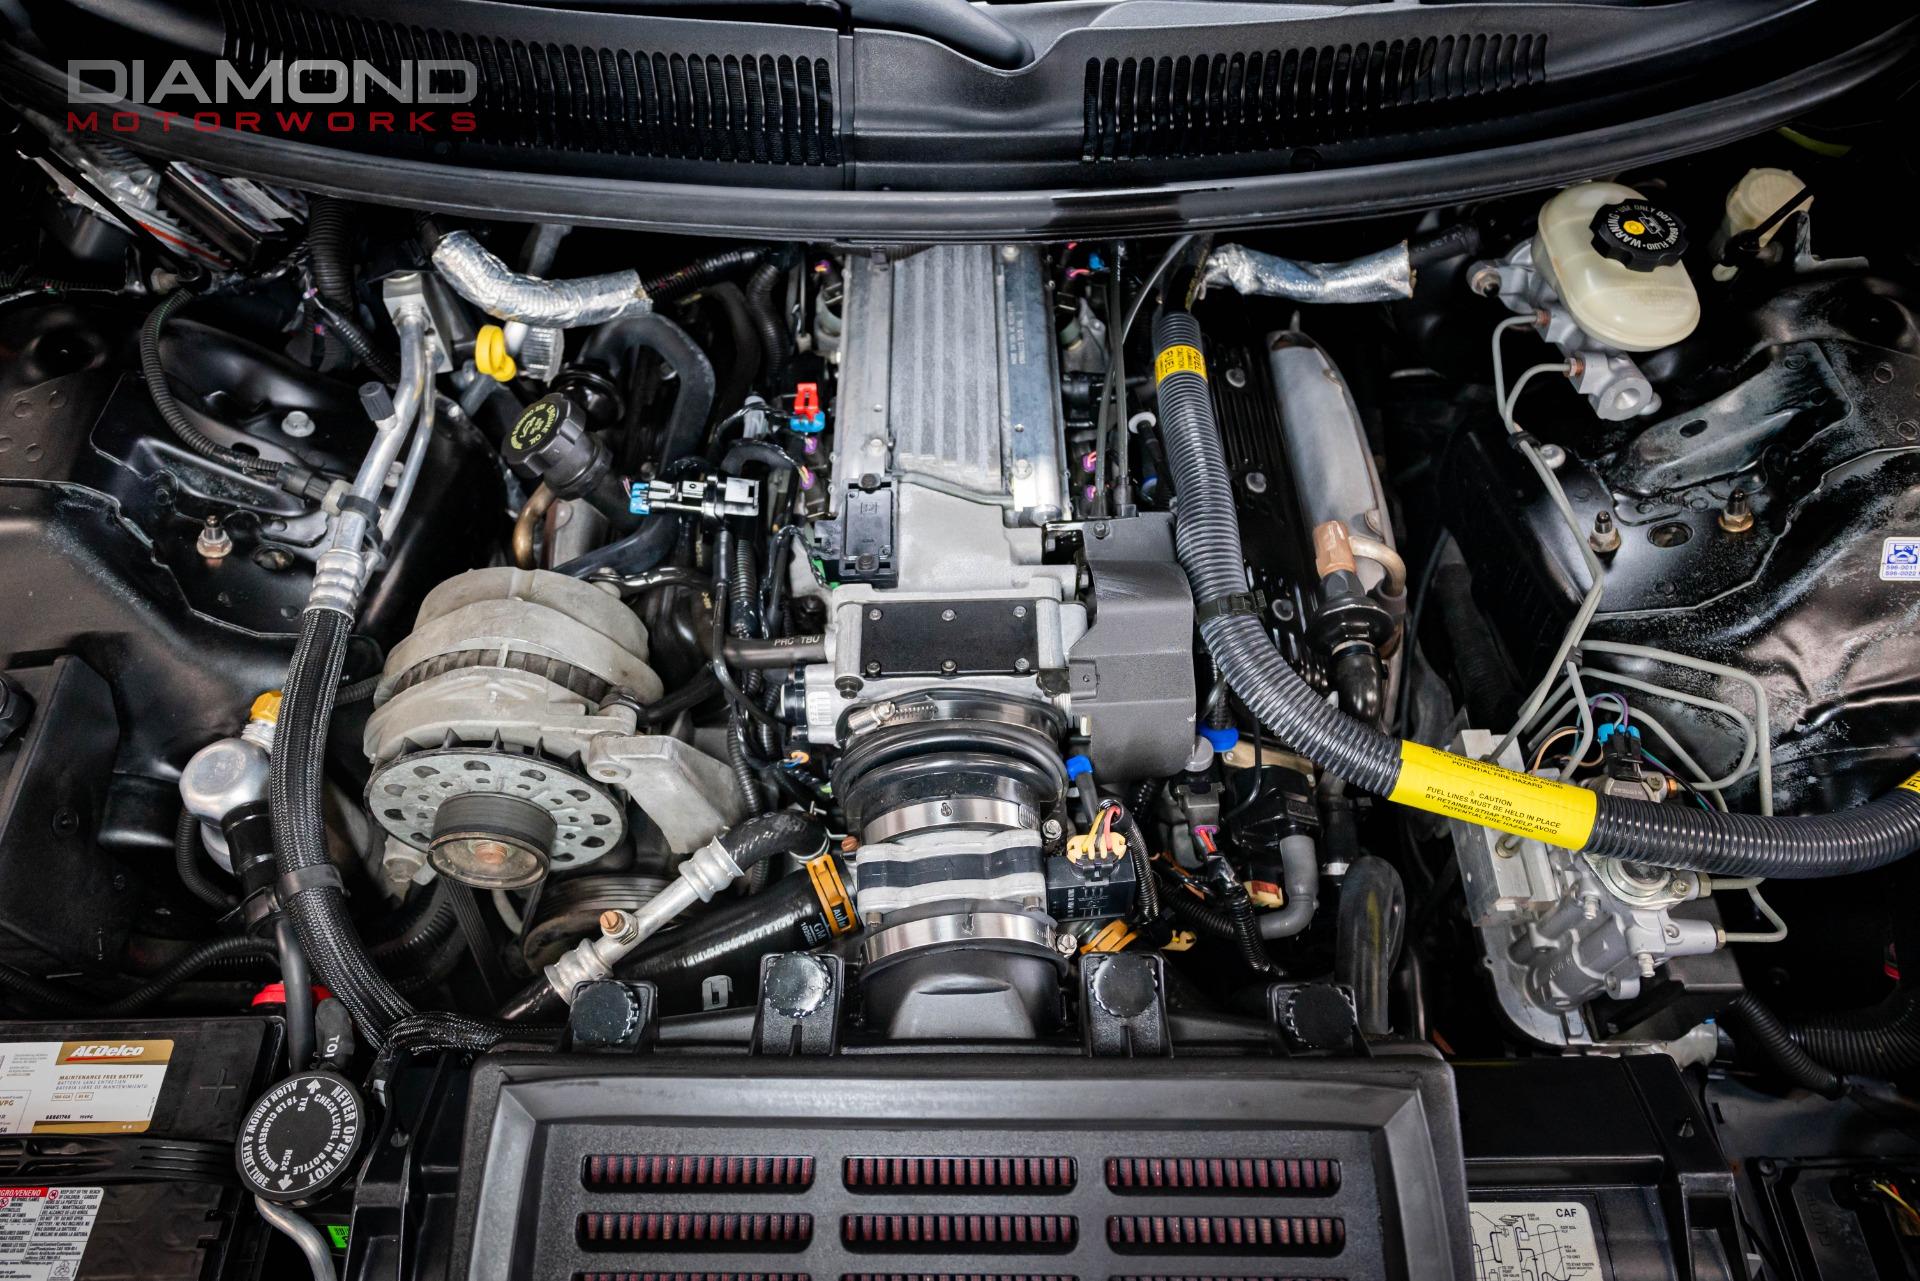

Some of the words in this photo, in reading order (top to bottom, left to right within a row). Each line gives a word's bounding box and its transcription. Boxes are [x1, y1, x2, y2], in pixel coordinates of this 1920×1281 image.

[1656, 211, 1673, 223] DOT
[1608, 213, 1641, 248] WARNING
[1647, 241, 1669, 250] FLUID
[529, 434, 542, 445] OIL
[1427, 786, 1446, 796] FUEL
[1447, 792, 1469, 803] LINES
[1470, 798, 1492, 809] MUST
[1504, 808, 1525, 818] HELD
[1536, 817, 1561, 829] PLACE
[1479, 793, 1513, 807] CAUTION
[1437, 797, 1474, 811] RETAINER
[1475, 807, 1500, 818] STRAP
[1513, 818, 1533, 827] HELP
[1534, 824, 1558, 835] AVOID
[814, 922, 825, 939] GM
[69, 1044, 145, 1057] ACDelco
[270, 1080, 298, 1103] ALIGN
[286, 1096, 298, 1107] 18
[276, 1103, 287, 1113] LB
[314, 1093, 337, 1116] CHECK
[331, 1086, 356, 1122] NEVER
[246, 1101, 271, 1134] ARROW
[258, 1112, 278, 1144] CLOSED
[330, 1113, 341, 1140] LEVEL
[323, 1141, 335, 1153] IN
[331, 1125, 356, 1161] OPEN
[243, 1144, 256, 1168] VENT
[258, 1144, 279, 1172] SYSTEM
[280, 1149, 293, 1171] RC24
[293, 1152, 327, 1175] BOTTLE
[250, 1167, 270, 1188] TUBE
[309, 1160, 334, 1185] HOT
[1556, 1208, 1577, 1217] CAF
